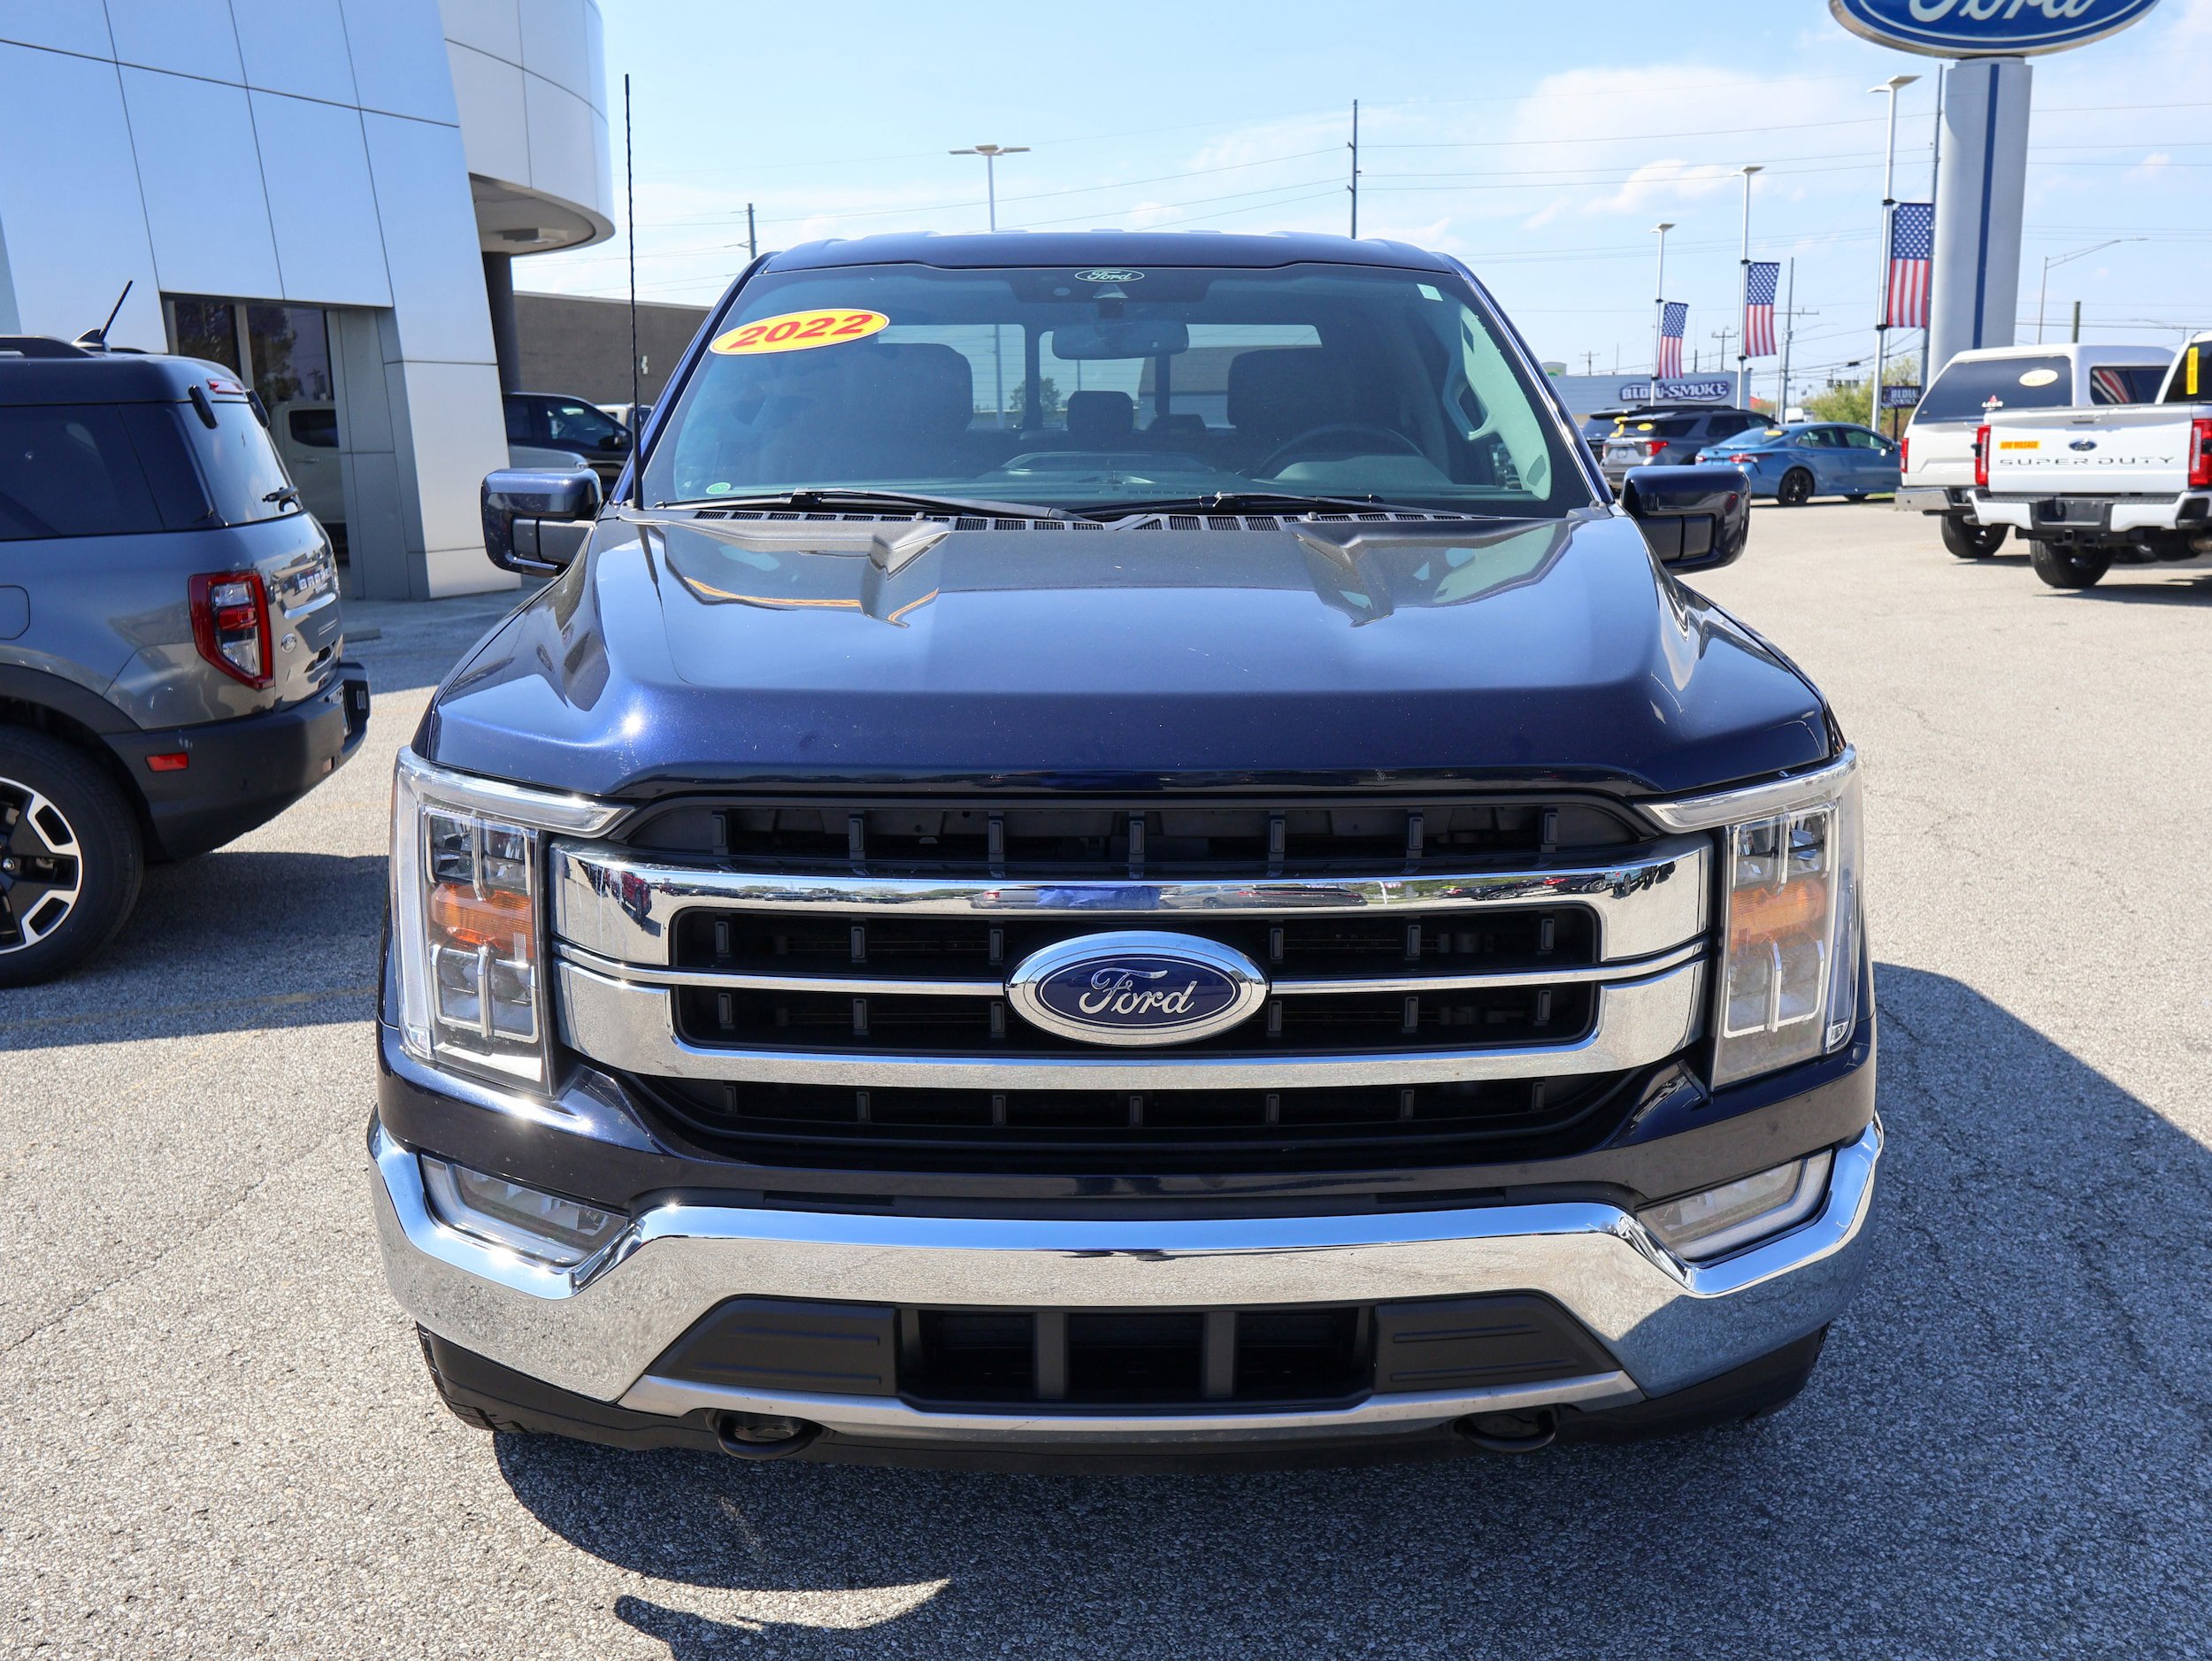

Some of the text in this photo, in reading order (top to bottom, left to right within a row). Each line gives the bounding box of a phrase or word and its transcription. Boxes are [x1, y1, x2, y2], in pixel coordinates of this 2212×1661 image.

[1087, 271, 1132, 280] Ford
[726, 315, 872, 349] 2022
[1079, 967, 1197, 1014] Ford
